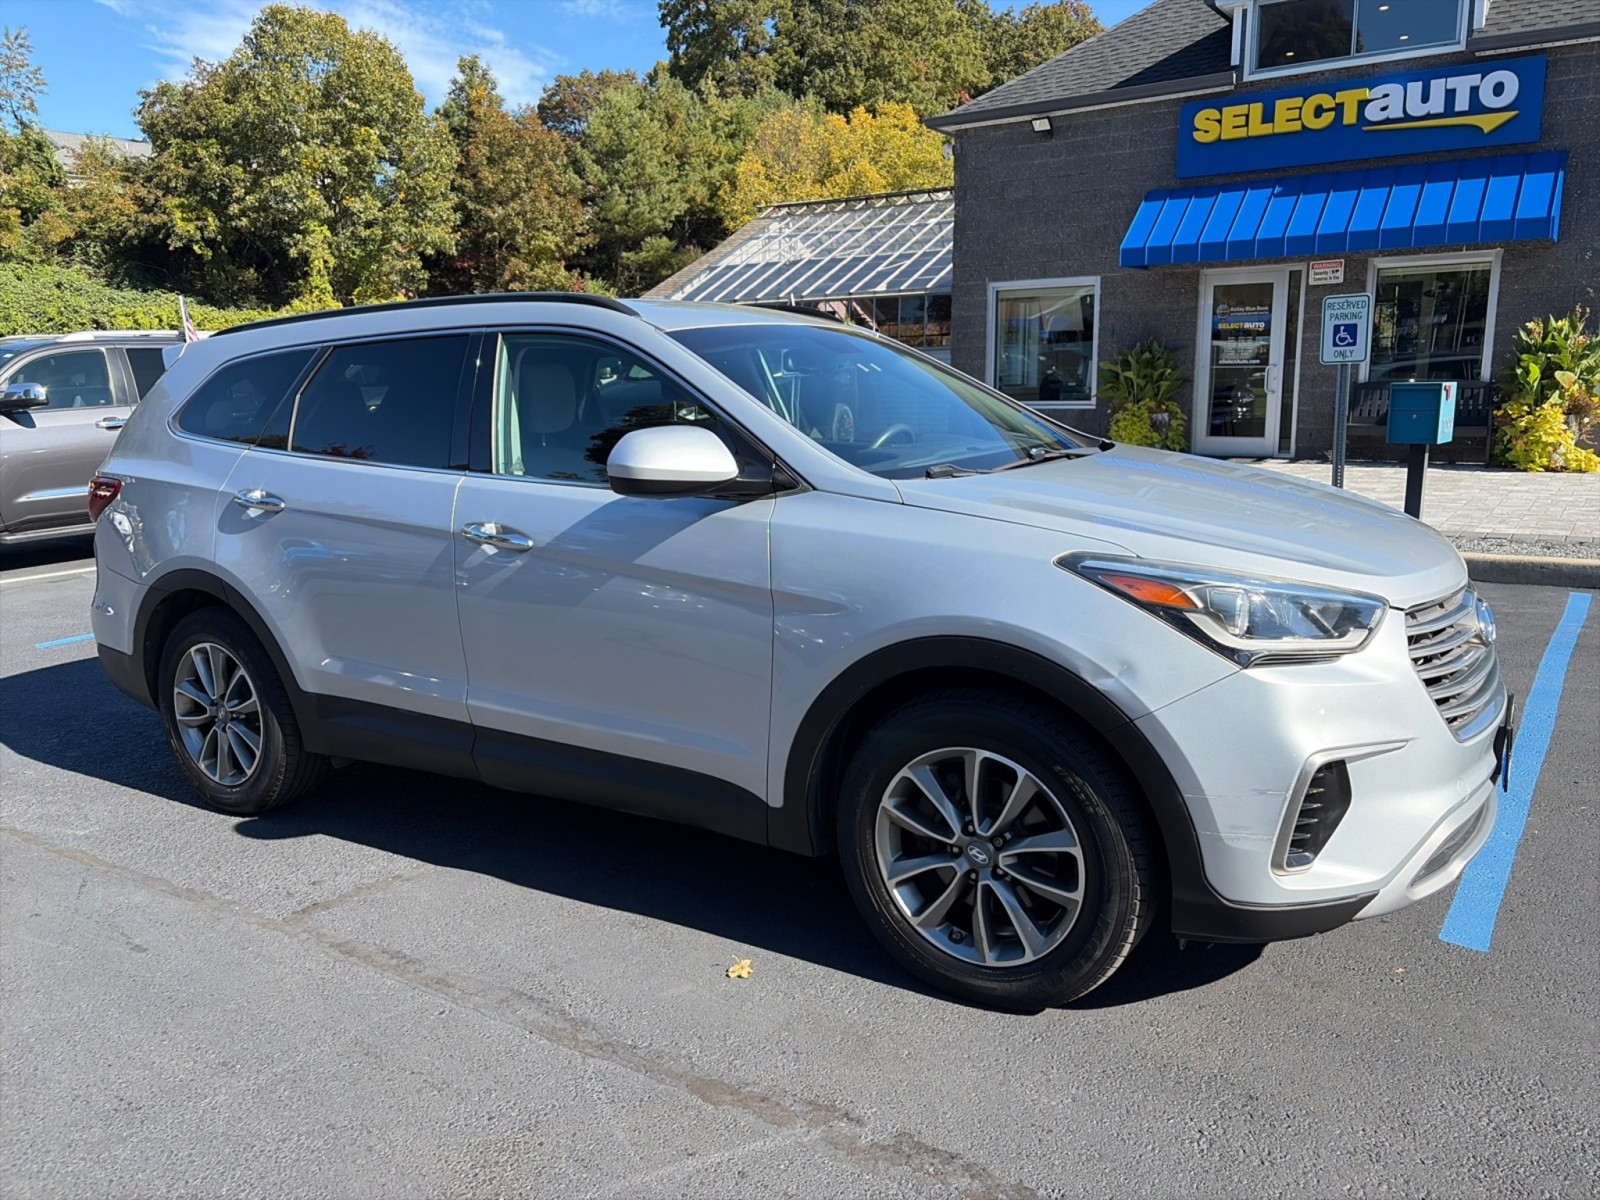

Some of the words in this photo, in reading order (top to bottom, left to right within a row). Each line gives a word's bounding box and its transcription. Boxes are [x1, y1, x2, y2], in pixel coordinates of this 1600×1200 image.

[1313, 261, 1341, 269] WARNING
[1327, 300, 1367, 311] RESERVED
[1330, 311, 1363, 321] PARKING
[1333, 349, 1355, 359] ONLY
